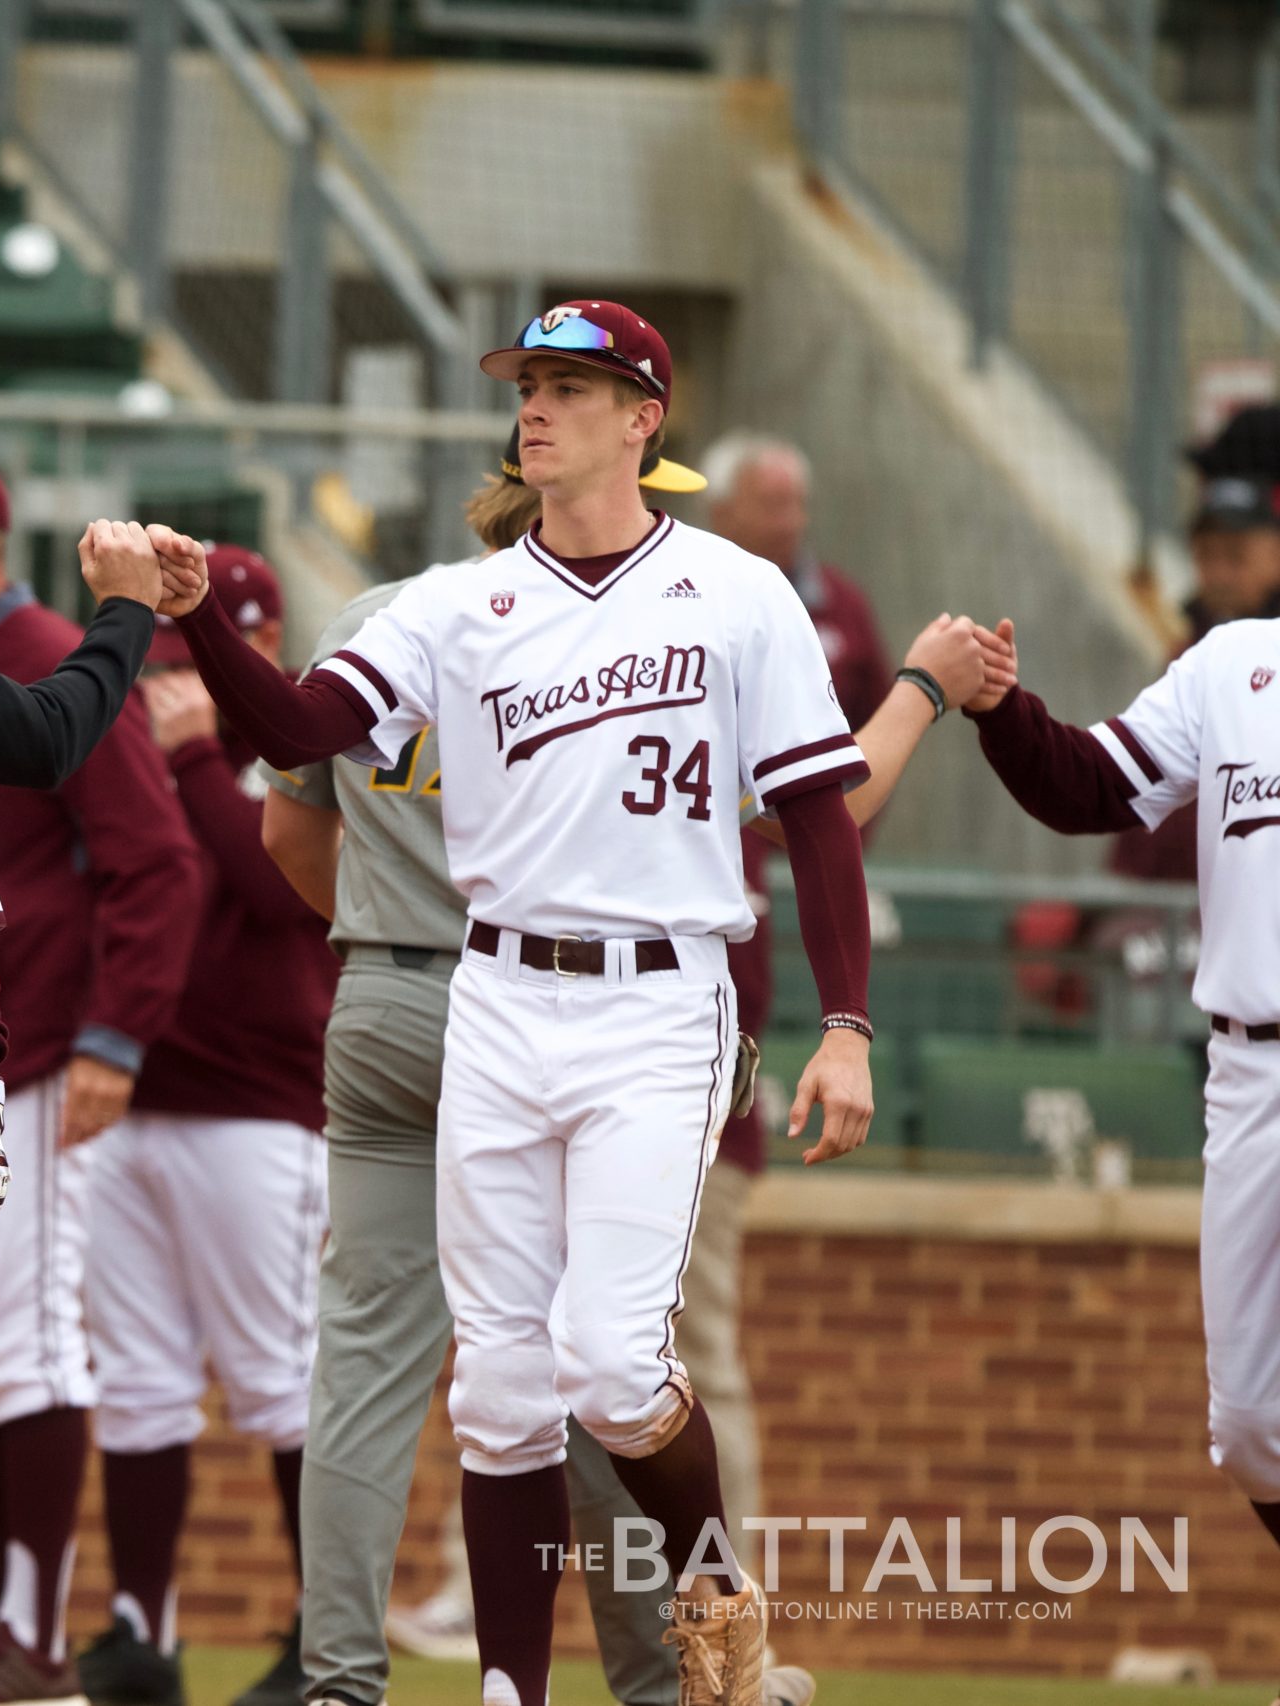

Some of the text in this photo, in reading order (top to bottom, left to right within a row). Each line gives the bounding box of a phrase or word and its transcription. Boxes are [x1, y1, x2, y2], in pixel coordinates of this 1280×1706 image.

[492, 598, 511, 611] 41
[661, 588, 702, 599] adidas
[481, 645, 707, 753] Texas A&M
[621, 734, 712, 822] 34
